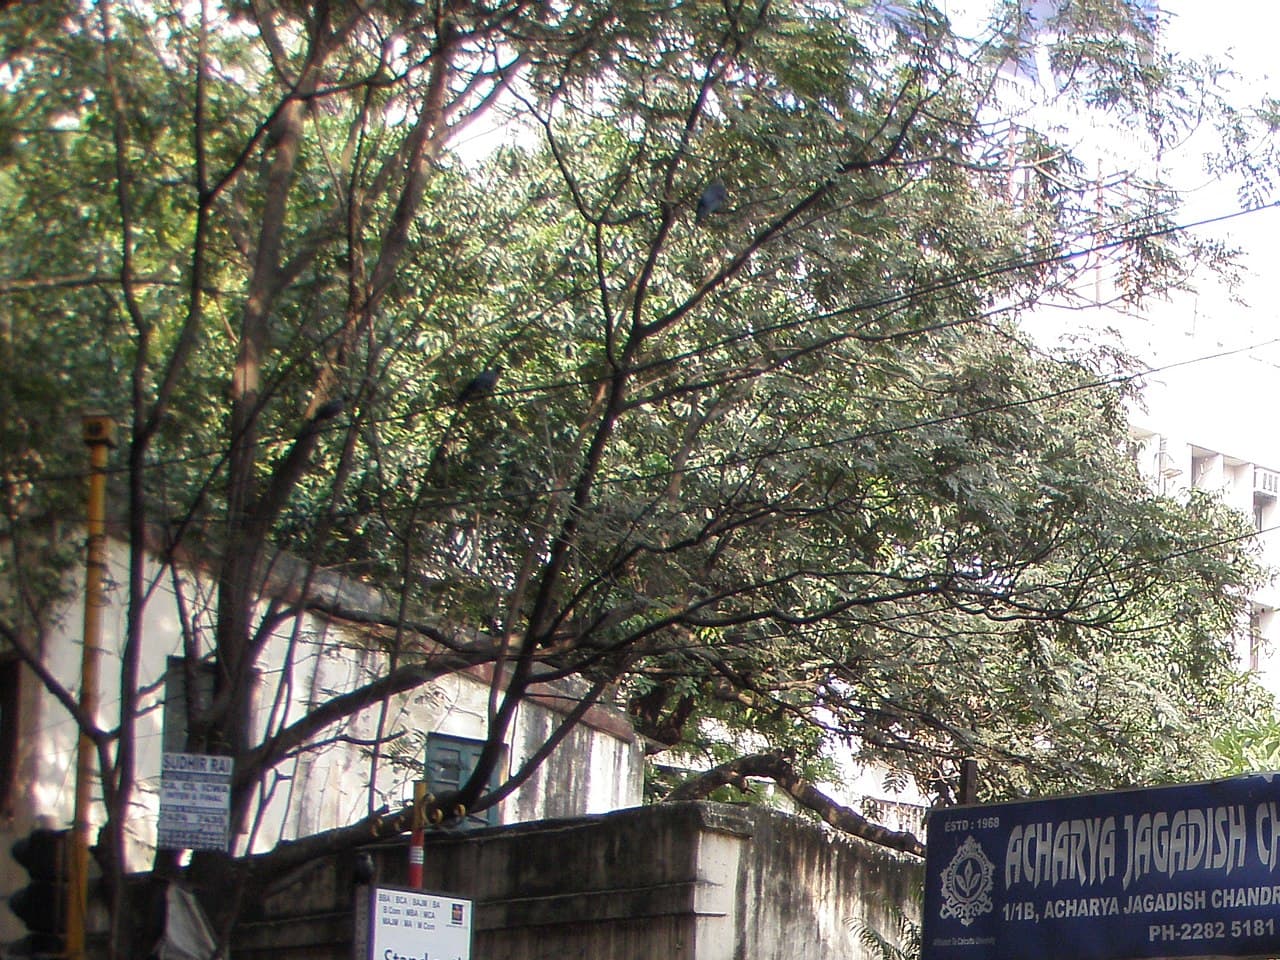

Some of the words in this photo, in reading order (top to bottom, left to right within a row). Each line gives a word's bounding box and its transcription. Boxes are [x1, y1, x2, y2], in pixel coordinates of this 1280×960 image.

[945, 820, 968, 832] ESTD
[976, 817, 1000, 829] 1968
[1005, 816, 1116, 891] ACHARYA
[1122, 805, 1246, 891] JAGADISH
[1002, 902, 1039, 923] 1/1B,
[1044, 897, 1120, 920] ACHARYA
[1123, 891, 1206, 914] JAGADISH
[1149, 921, 1225, 942] PH-2282
[1231, 918, 1274, 938] 5181
